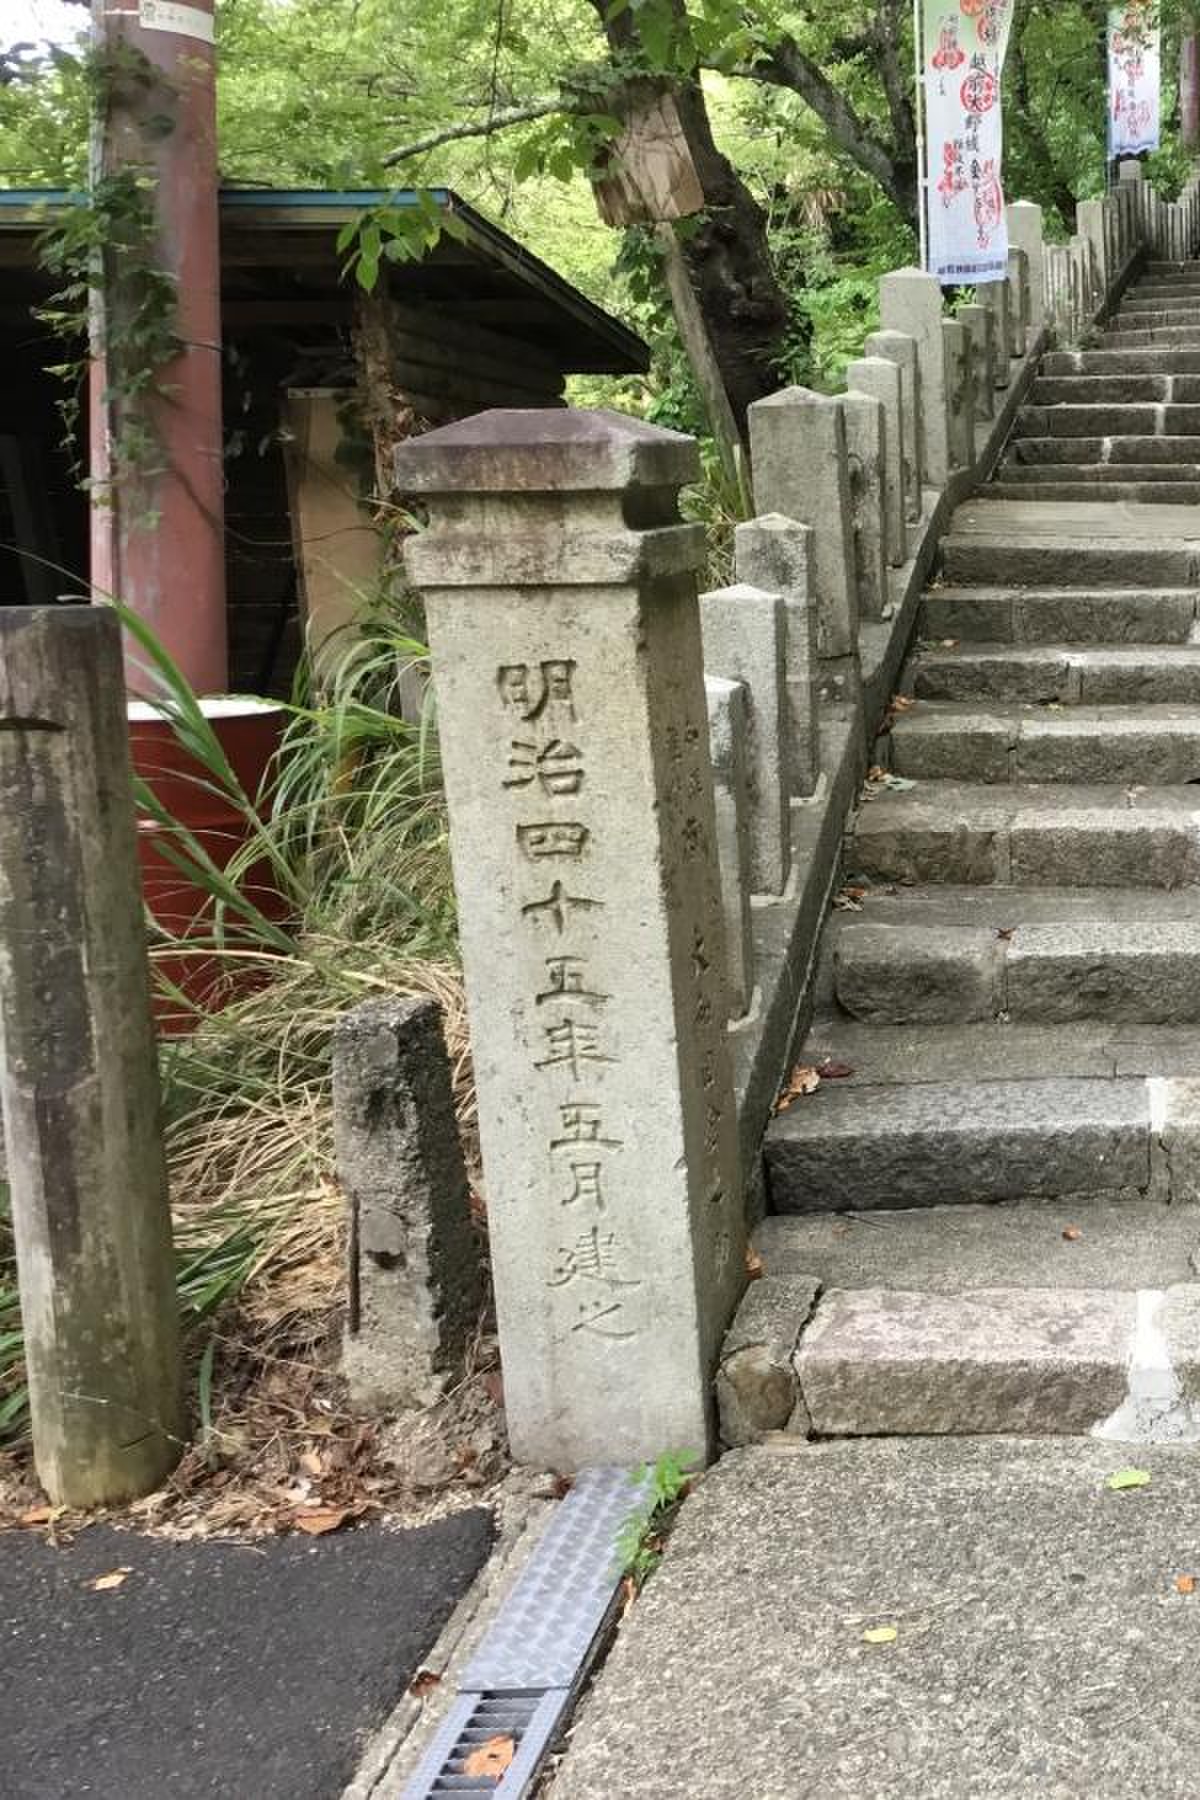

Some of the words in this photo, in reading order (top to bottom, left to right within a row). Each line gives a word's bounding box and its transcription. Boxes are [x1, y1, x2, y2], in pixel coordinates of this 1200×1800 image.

[496, 659, 641, 1338] 明治四十五年五月建之
